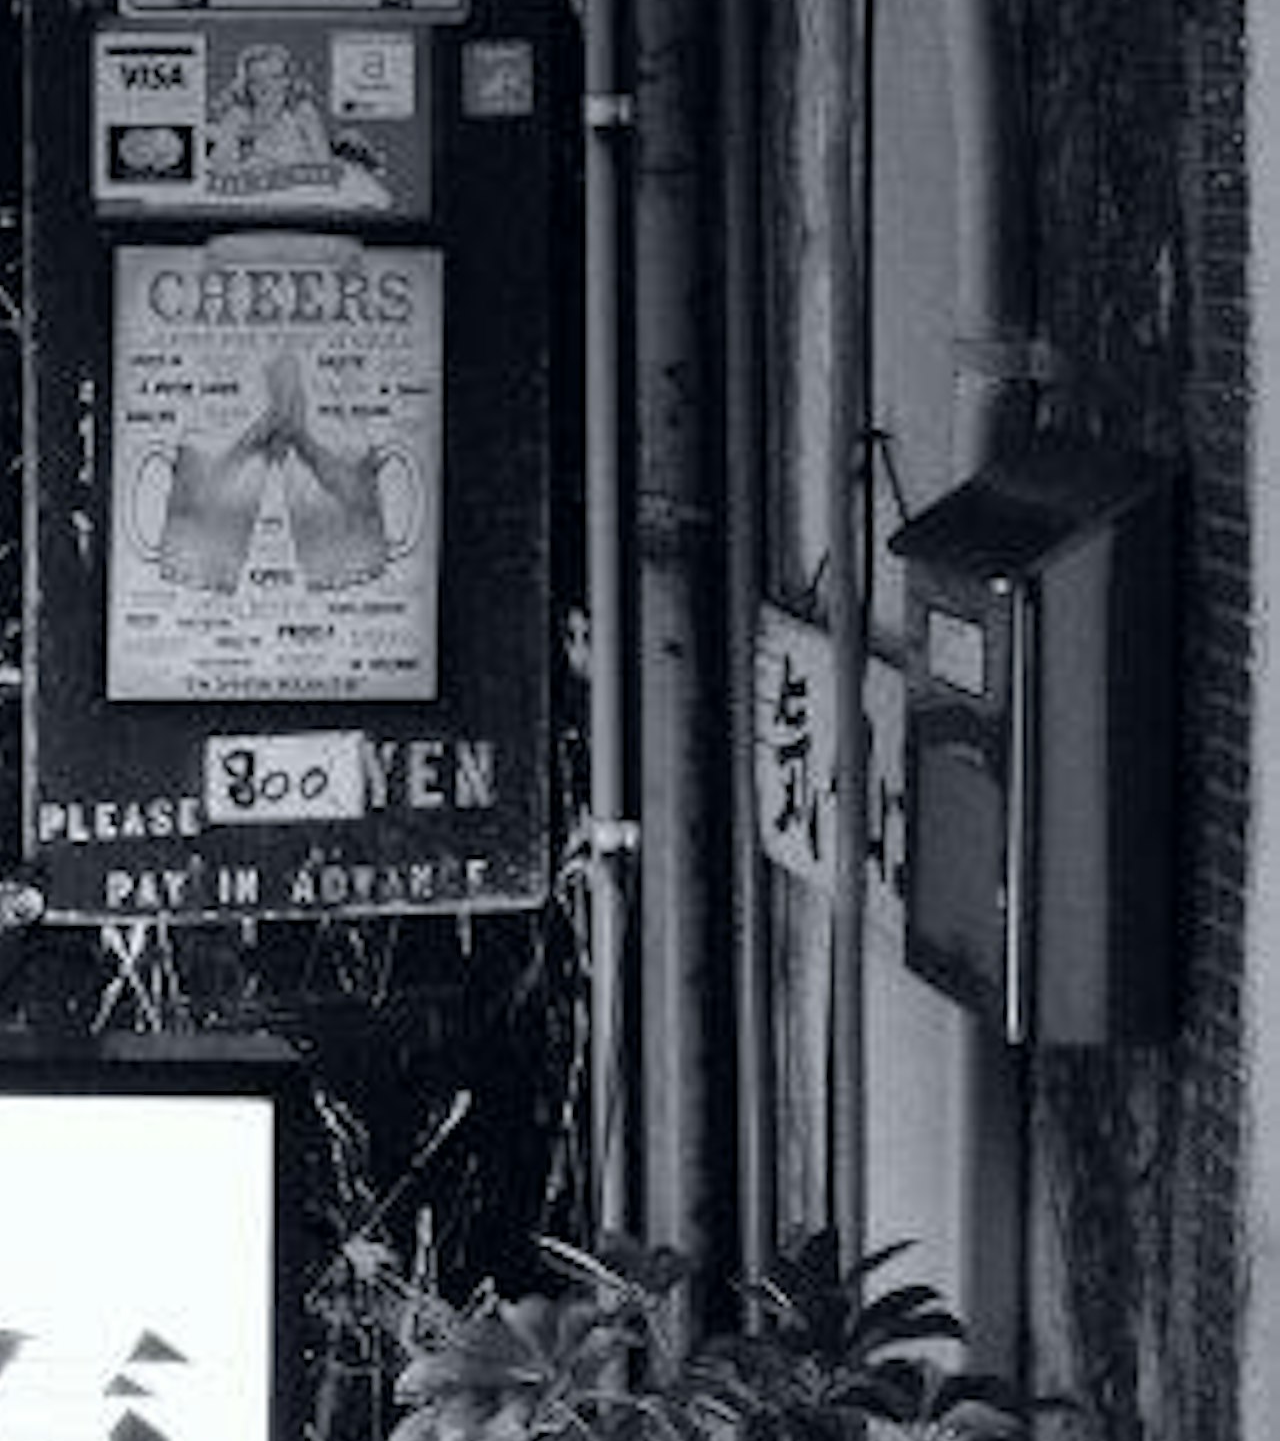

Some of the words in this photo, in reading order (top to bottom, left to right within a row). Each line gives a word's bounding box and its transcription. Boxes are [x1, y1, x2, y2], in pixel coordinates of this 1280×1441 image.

[120, 63, 187, 91] VISA
[148, 268, 414, 324] CHEERS
[222, 749, 329, 807] 800
[362, 740, 496, 808] YEN
[39, 797, 201, 842] PLEASE
[104, 867, 187, 909] PAY
[217, 865, 260, 905] IN
